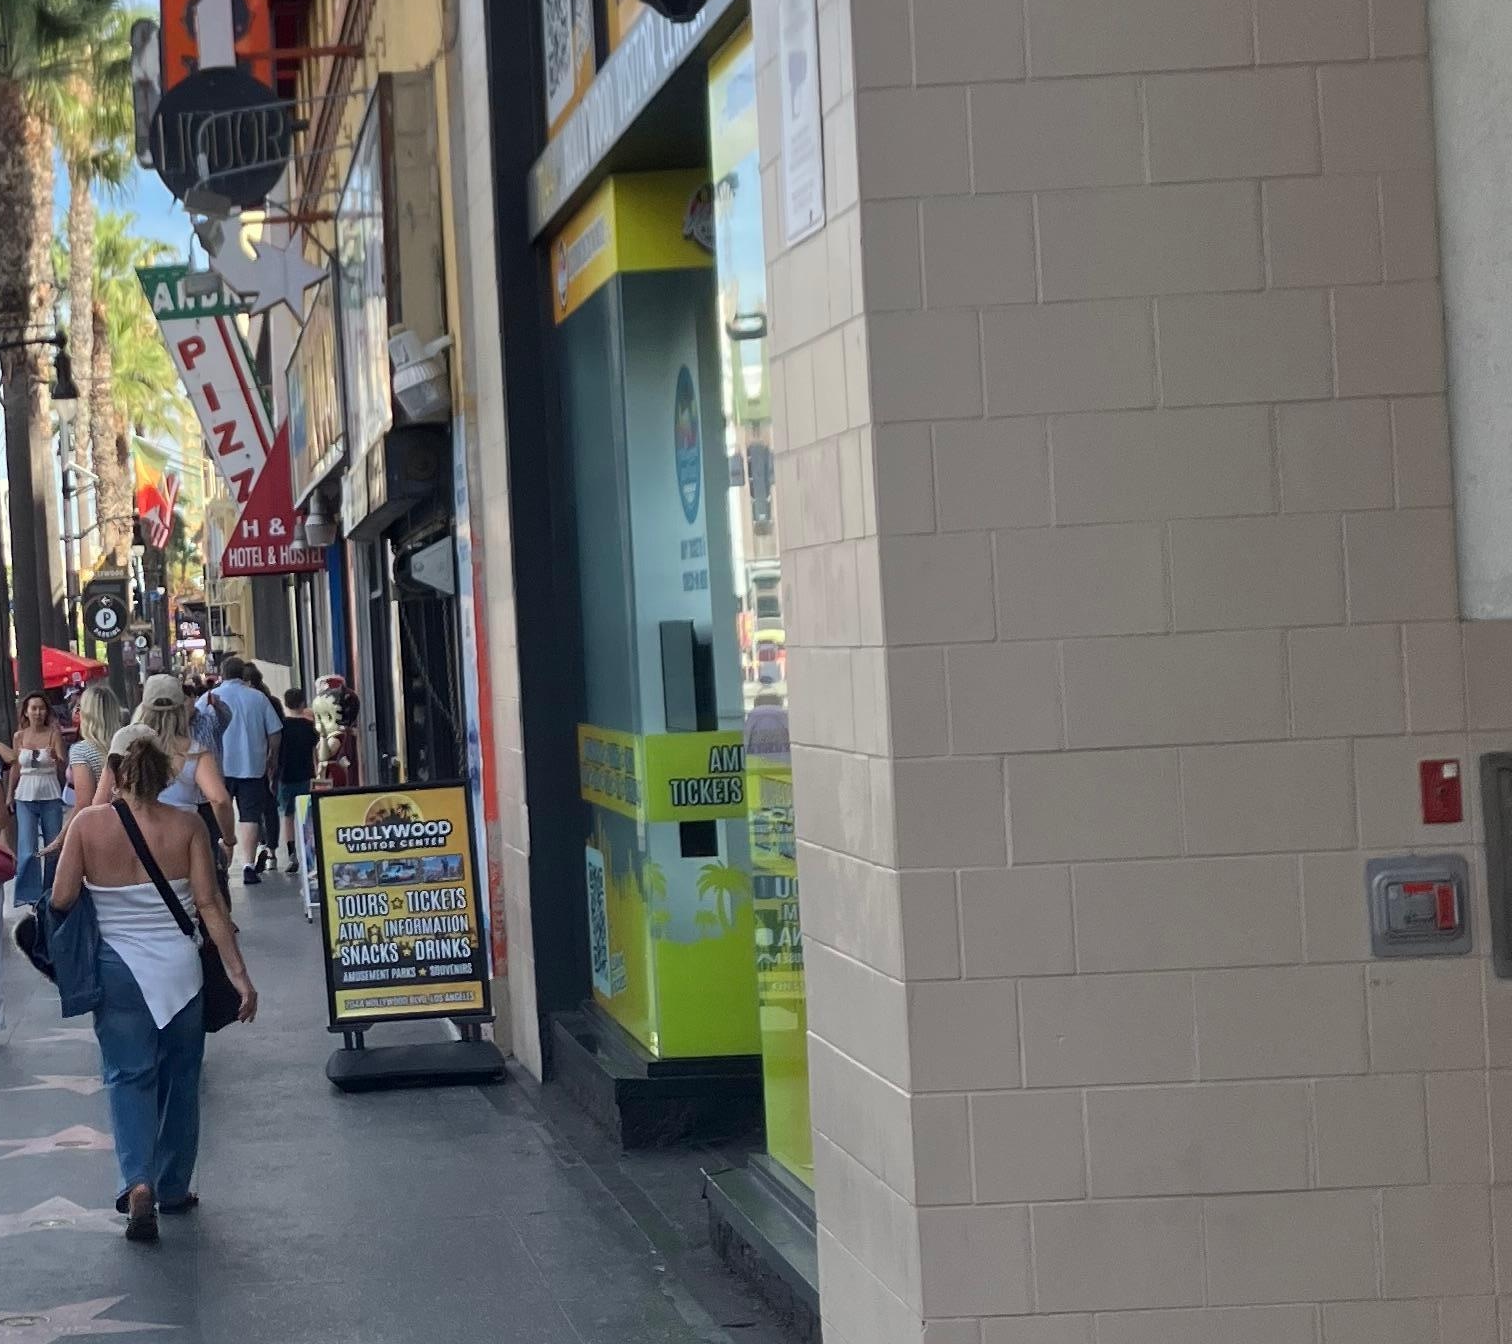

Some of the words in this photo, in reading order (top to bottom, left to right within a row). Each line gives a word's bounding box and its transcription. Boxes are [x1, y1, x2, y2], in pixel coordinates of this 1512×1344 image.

[177, 335, 256, 504] PIZZ
[242, 519, 260, 539] H
[269, 517, 286, 536] &
[229, 546, 265, 569] HOTEL
[268, 545, 277, 565] &
[280, 545, 325, 566] HOSTEL
[102, 611, 111, 626] P
[670, 777, 743, 806] TICKETS
[337, 819, 452, 845] HOLLYWOOD
[347, 839, 396, 853] VISITOR
[399, 835, 446, 849] CENTER
[336, 893, 389, 919] TOURS
[405, 887, 467, 913] TICKETS
[339, 922, 366, 942] ATM
[384, 914, 470, 939] INFORMATION
[340, 941, 399, 967] SNACKS
[414, 936, 472, 962] DRINKS
[343, 968, 389, 983] AMUSEMENT
[391, 966, 416, 979] PARKS
[429, 962, 473, 977] SOUVENIRS
